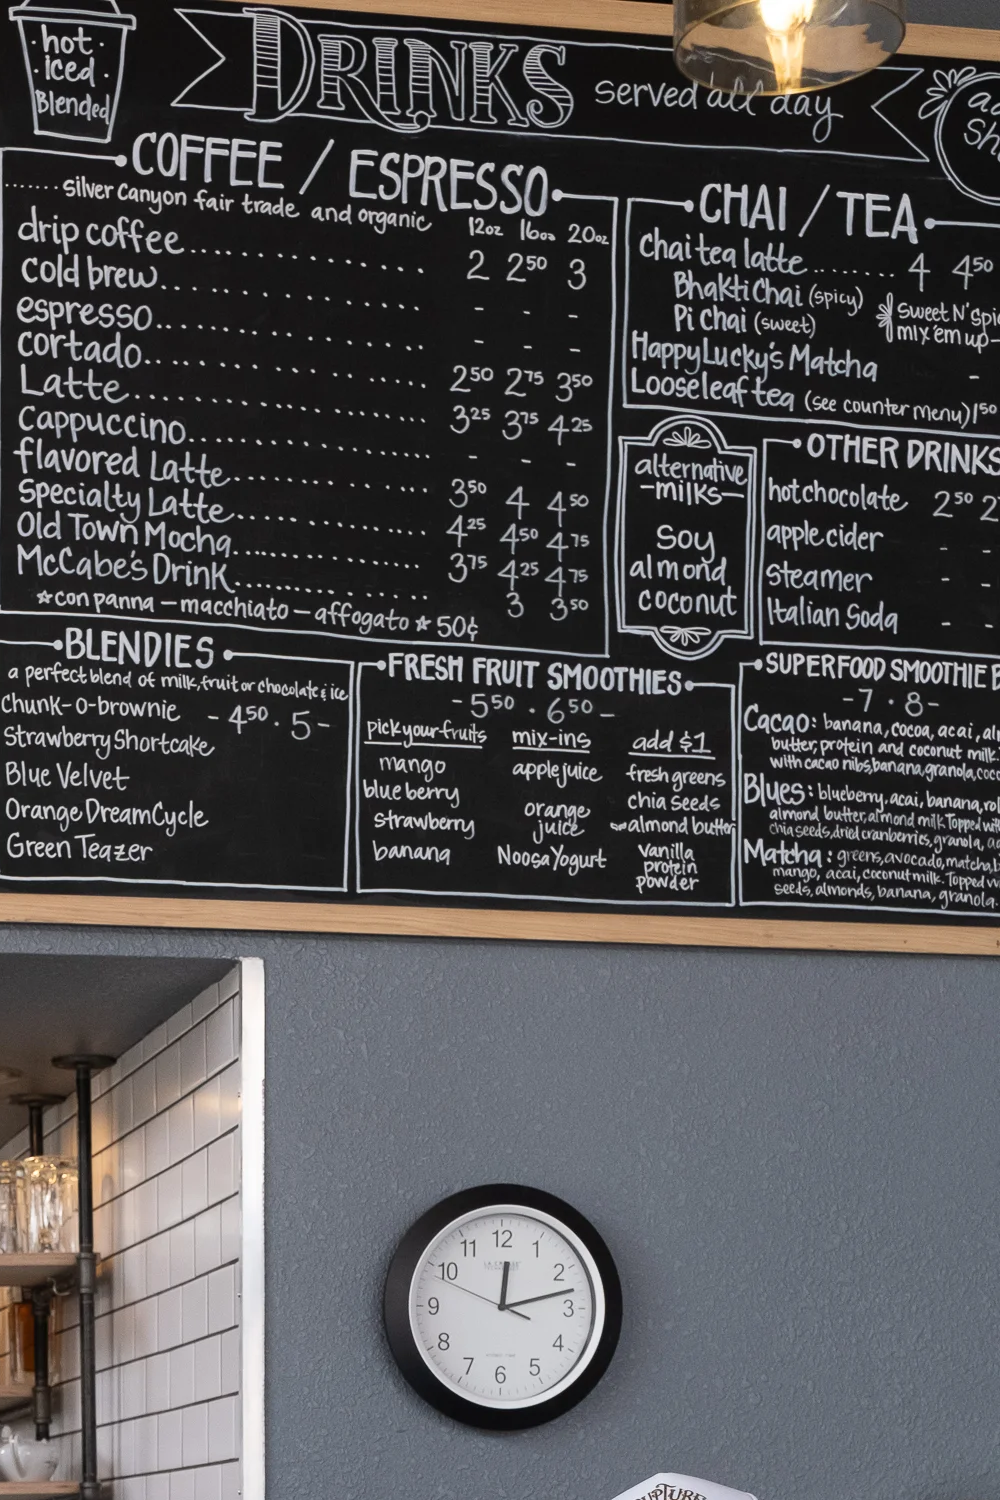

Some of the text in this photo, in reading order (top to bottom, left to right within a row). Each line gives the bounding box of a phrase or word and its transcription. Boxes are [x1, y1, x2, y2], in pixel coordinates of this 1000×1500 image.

[41, 24, 93, 54] hot
[45, 55, 95, 87] iced
[243, 7, 845, 143] DRINKS all day
[35, 89, 110, 122] Blended
[133, 132, 548, 218] COFFEE ESPRESSO
[194, 189, 234, 211] fair
[242, 194, 299, 217] trade
[311, 204, 352, 224] and
[358, 209, 432, 234] organic
[700, 184, 918, 244] CHAI TEA
[18, 206, 184, 255] drip coffee
[469, 217, 609, 244] 12oz 20oz
[695, 233, 736, 268] tea
[744, 238, 807, 275] latte
[22, 254, 157, 290] cold brew
[17, 297, 152, 330] espresso
[809, 284, 863, 316] (spicy)
[674, 304, 694, 332] Pi
[755, 312, 815, 338] (sweet)
[18, 330, 141, 368] cortado
[632, 330, 877, 386] Happy Lucky's Matcha
[21, 364, 129, 403] Latte
[632, 367, 970, 429] Loose leaf tea (see counter menu)
[19, 406, 185, 448] Cappuccino
[13, 437, 230, 488] flavored Latte
[807, 433, 899, 468] OTHER
[635, 453, 748, 485] alternative
[149, 487, 234, 523] Latte
[769, 477, 908, 511] hot chocolate
[17, 510, 231, 558] Old Town Mocha
[767, 520, 883, 551] apple cider
[17, 544, 238, 593] McCabe's Drink
[630, 551, 726, 585] almond
[55, 591, 89, 606] con
[93, 593, 154, 613] panna
[181, 597, 288, 620] macchiato
[315, 602, 409, 634] affogato
[639, 586, 737, 617] coconut
[768, 596, 839, 627] Italian
[66, 627, 213, 669] BLENDIES
[8, 662, 348, 700] a perfect blend of fruit or chocolate ice
[389, 653, 681, 695] FRESH FRUIT SMOOTHIES
[766, 652, 987, 688] SUPERFOOD SMOOTHIE
[4, 725, 215, 759] Strawberry Shortcake
[367, 719, 487, 748] pick your fruits
[512, 730, 591, 750] mix-ins
[633, 729, 711, 753] add $1
[820, 737, 962, 759] protein and coconut
[6, 761, 130, 790] Blue Velvet
[380, 757, 445, 782] mango
[513, 760, 602, 788] apple juice
[626, 764, 726, 792] fresh greens
[6, 798, 83, 832] Orange
[525, 803, 590, 826] orange
[628, 792, 666, 810] chia
[770, 806, 819, 821] almond
[374, 810, 474, 839] strawberry
[533, 817, 584, 844] juice
[628, 815, 688, 834] almond
[7, 832, 153, 862] Green Teazer
[373, 840, 450, 865] banana
[498, 844, 606, 876] Noosa Yogurt
[636, 873, 699, 894] powder
[642, 860, 697, 878] protein
[460, 1239, 477, 1257] 11
[492, 1229, 513, 1248] 12
[438, 1262, 459, 1281] 10
[553, 1263, 565, 1282] 2
[427, 1297, 440, 1315] 9
[563, 1300, 575, 1317] 3
[438, 1332, 450, 1351] 8
[552, 1334, 564, 1352] 4
[463, 1357, 476, 1375] 7
[495, 1365, 507, 1383] 6
[529, 1358, 541, 1376] 5
